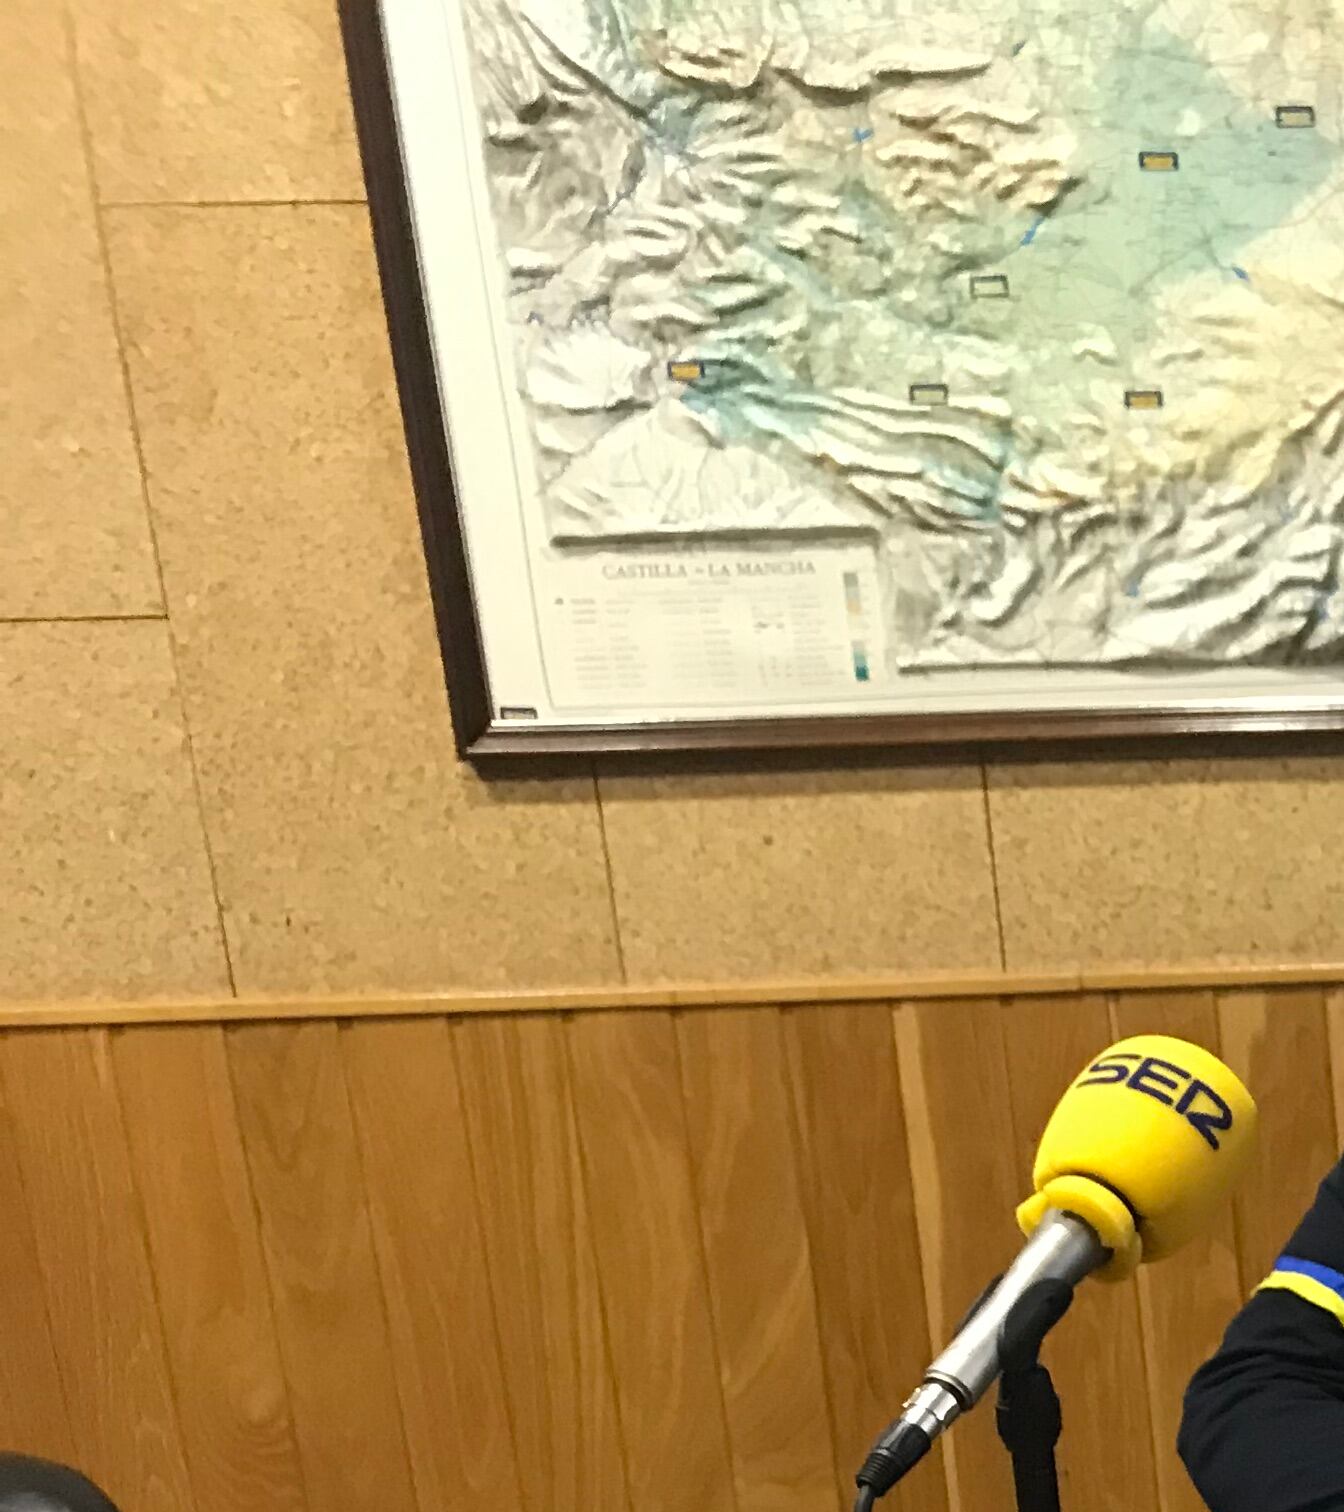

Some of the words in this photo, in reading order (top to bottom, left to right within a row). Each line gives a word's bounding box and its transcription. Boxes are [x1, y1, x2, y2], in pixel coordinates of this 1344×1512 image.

[602, 562, 688, 581] CASTILLA
[707, 562, 731, 578] LA
[735, 560, 817, 577] MANCHA
[1075, 1053, 1233, 1151] SER
